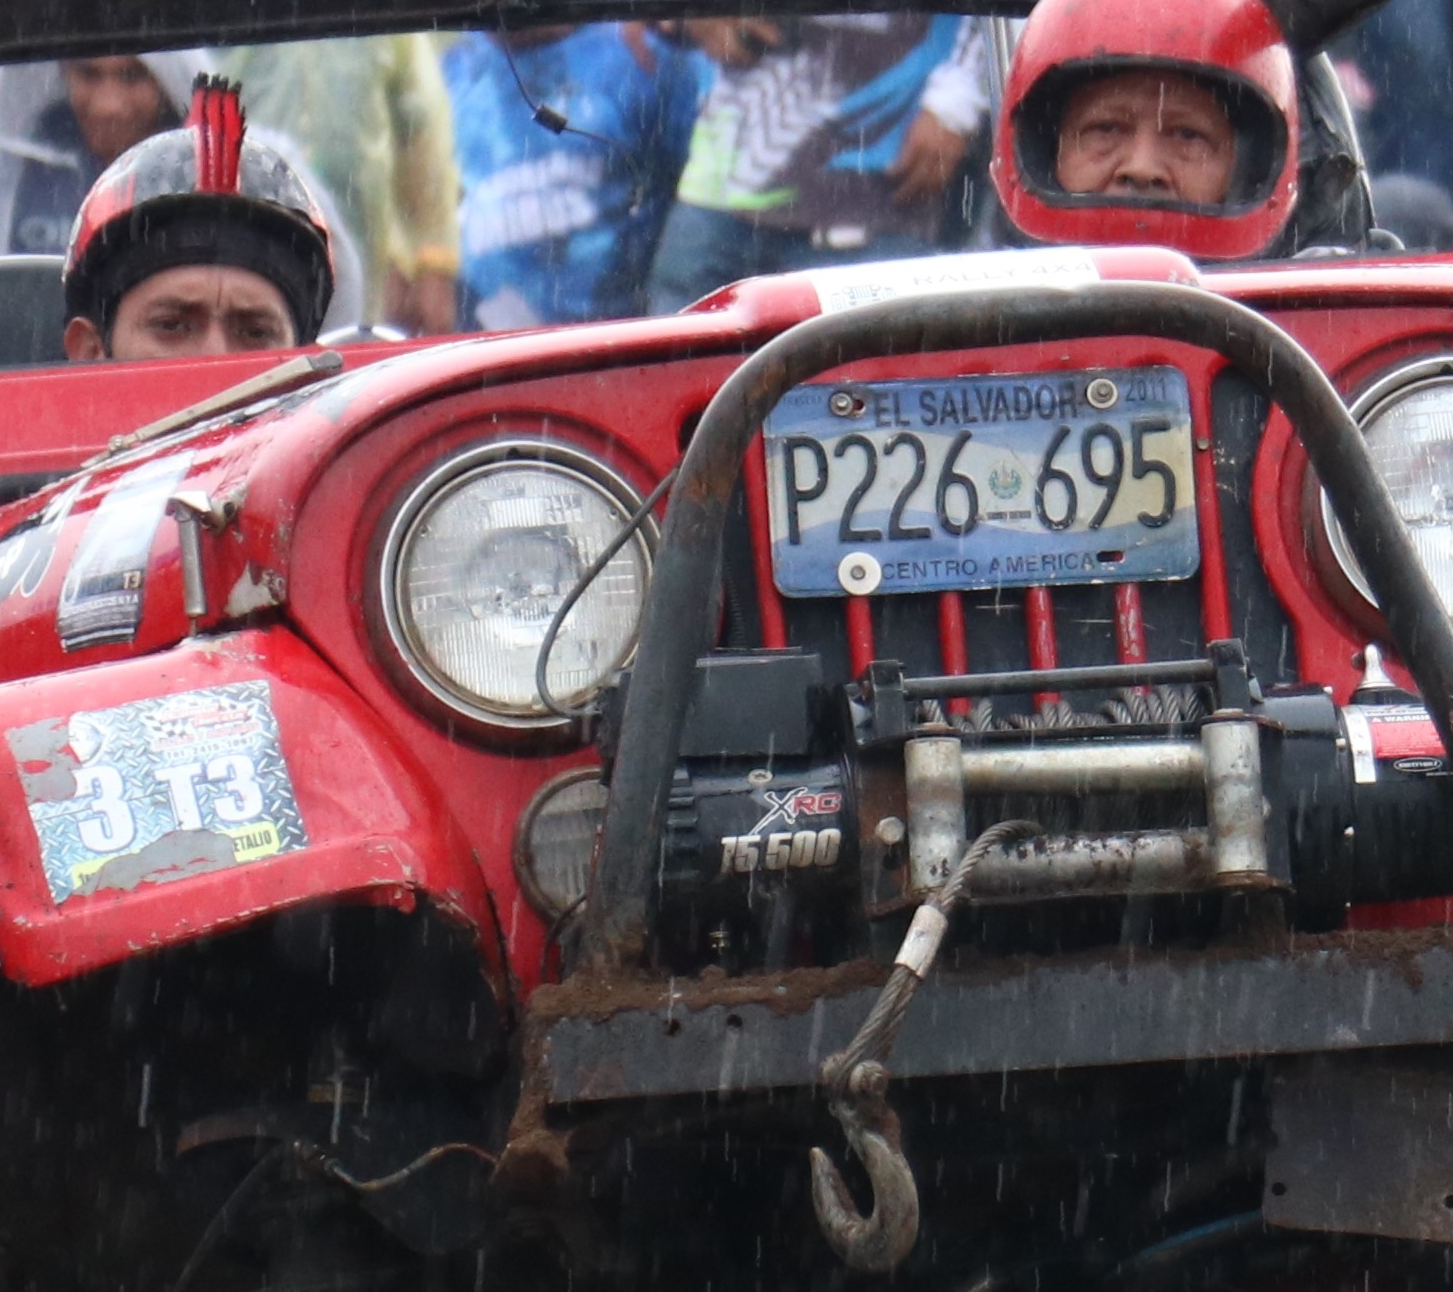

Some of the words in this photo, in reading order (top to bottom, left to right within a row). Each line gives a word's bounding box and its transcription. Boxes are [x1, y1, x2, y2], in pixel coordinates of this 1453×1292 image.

[913, 269, 1016, 287] RALLY
[874, 398, 905, 428] EL
[920, 385, 1079, 426] SALVADOR
[1125, 377, 1168, 402] 2011
[783, 429, 980, 546] P226
[1034, 418, 1178, 531] 695
[881, 559, 977, 581] CENTRO
[988, 552, 1096, 576] AMERICA
[154, 754, 264, 832] T3
[748, 787, 842, 836] XRC
